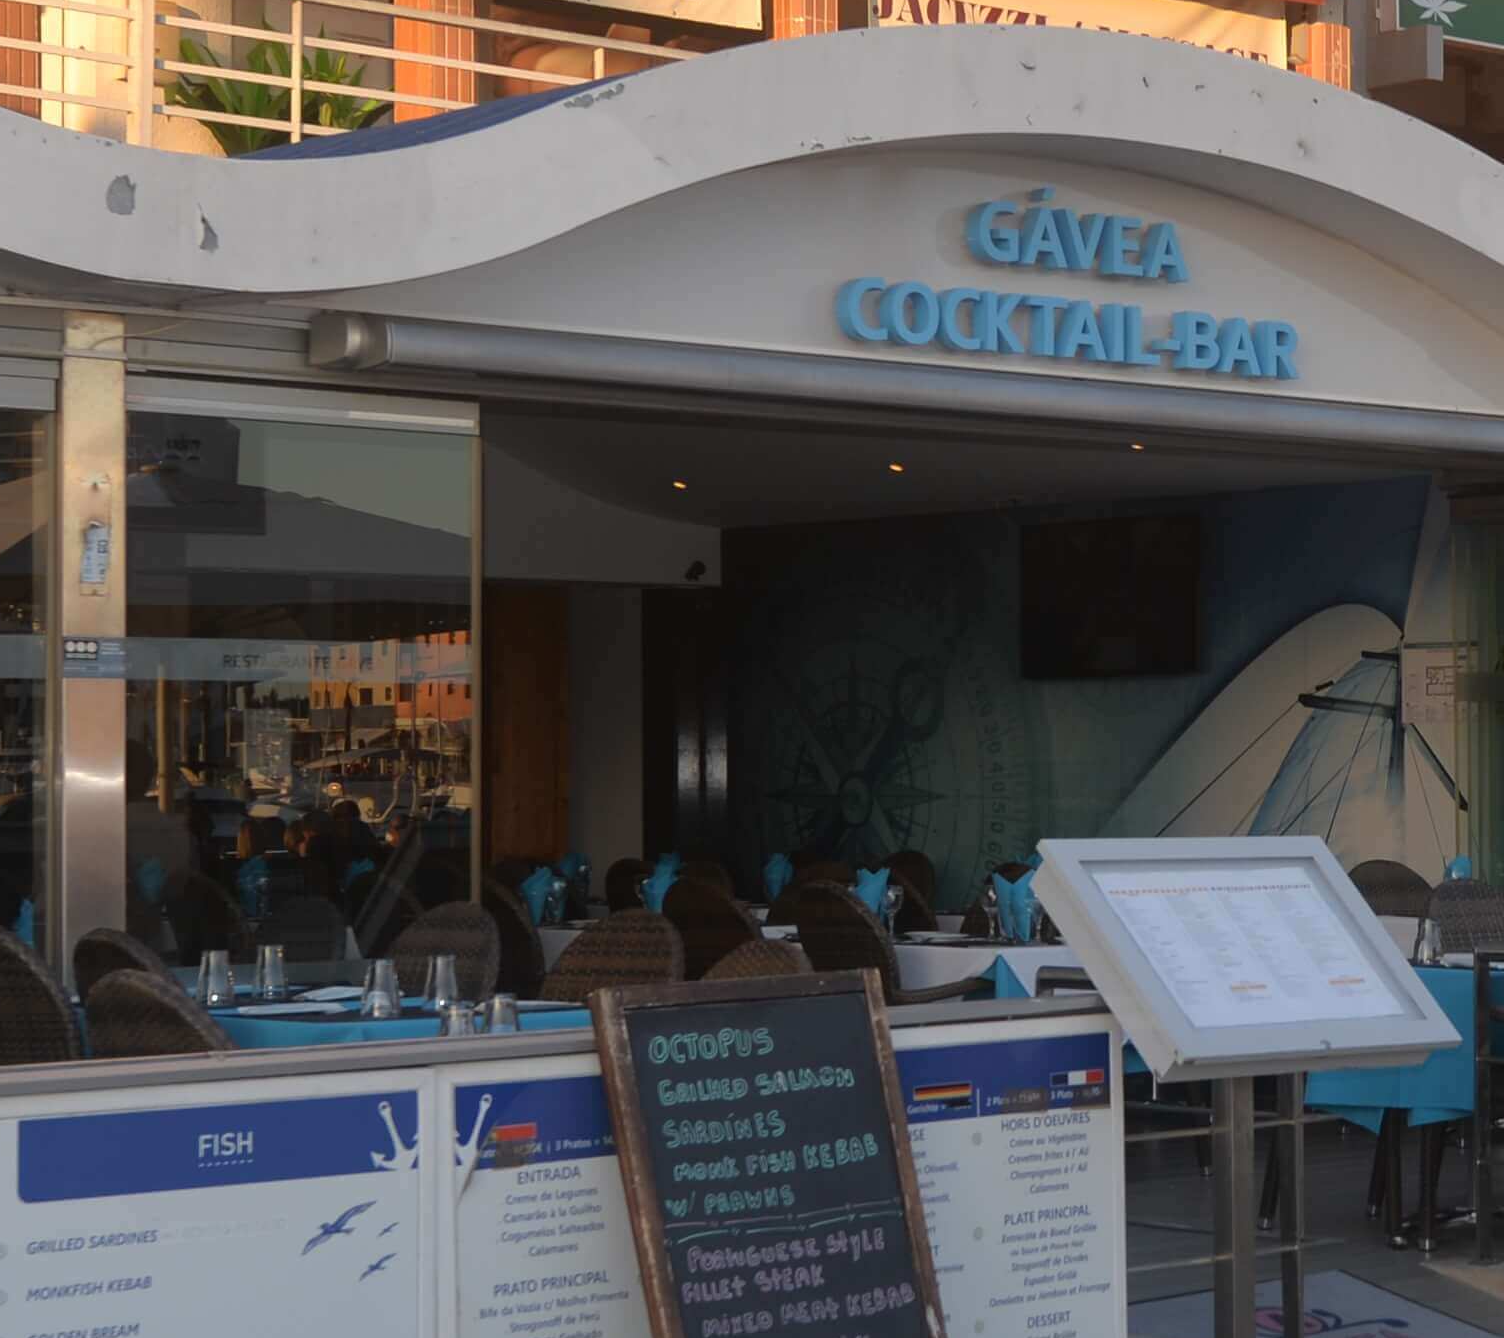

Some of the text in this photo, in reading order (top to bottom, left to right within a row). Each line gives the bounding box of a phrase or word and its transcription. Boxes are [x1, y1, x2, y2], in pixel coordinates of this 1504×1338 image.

[968, 186, 1189, 283] GÁVEA
[837, 276, 1299, 380] COCKTAIL-BAR
[649, 1027, 775, 1065] OCTOPUS
[1001, 1116, 1031, 1132] HORS
[197, 1131, 254, 1158] FISH
[802, 1132, 880, 1170] KEBAB
[516, 1165, 582, 1186] ENTRADA
[1004, 1204, 1092, 1226] PLATE PRINCIPAL
[26, 1230, 159, 1255] GRILLED SARDINES
[26, 1275, 152, 1301] MONKFISH KEBAB
[493, 1269, 610, 1297] PRATO PRINCIPAL
[1027, 1310, 1071, 1329] DESSERT
